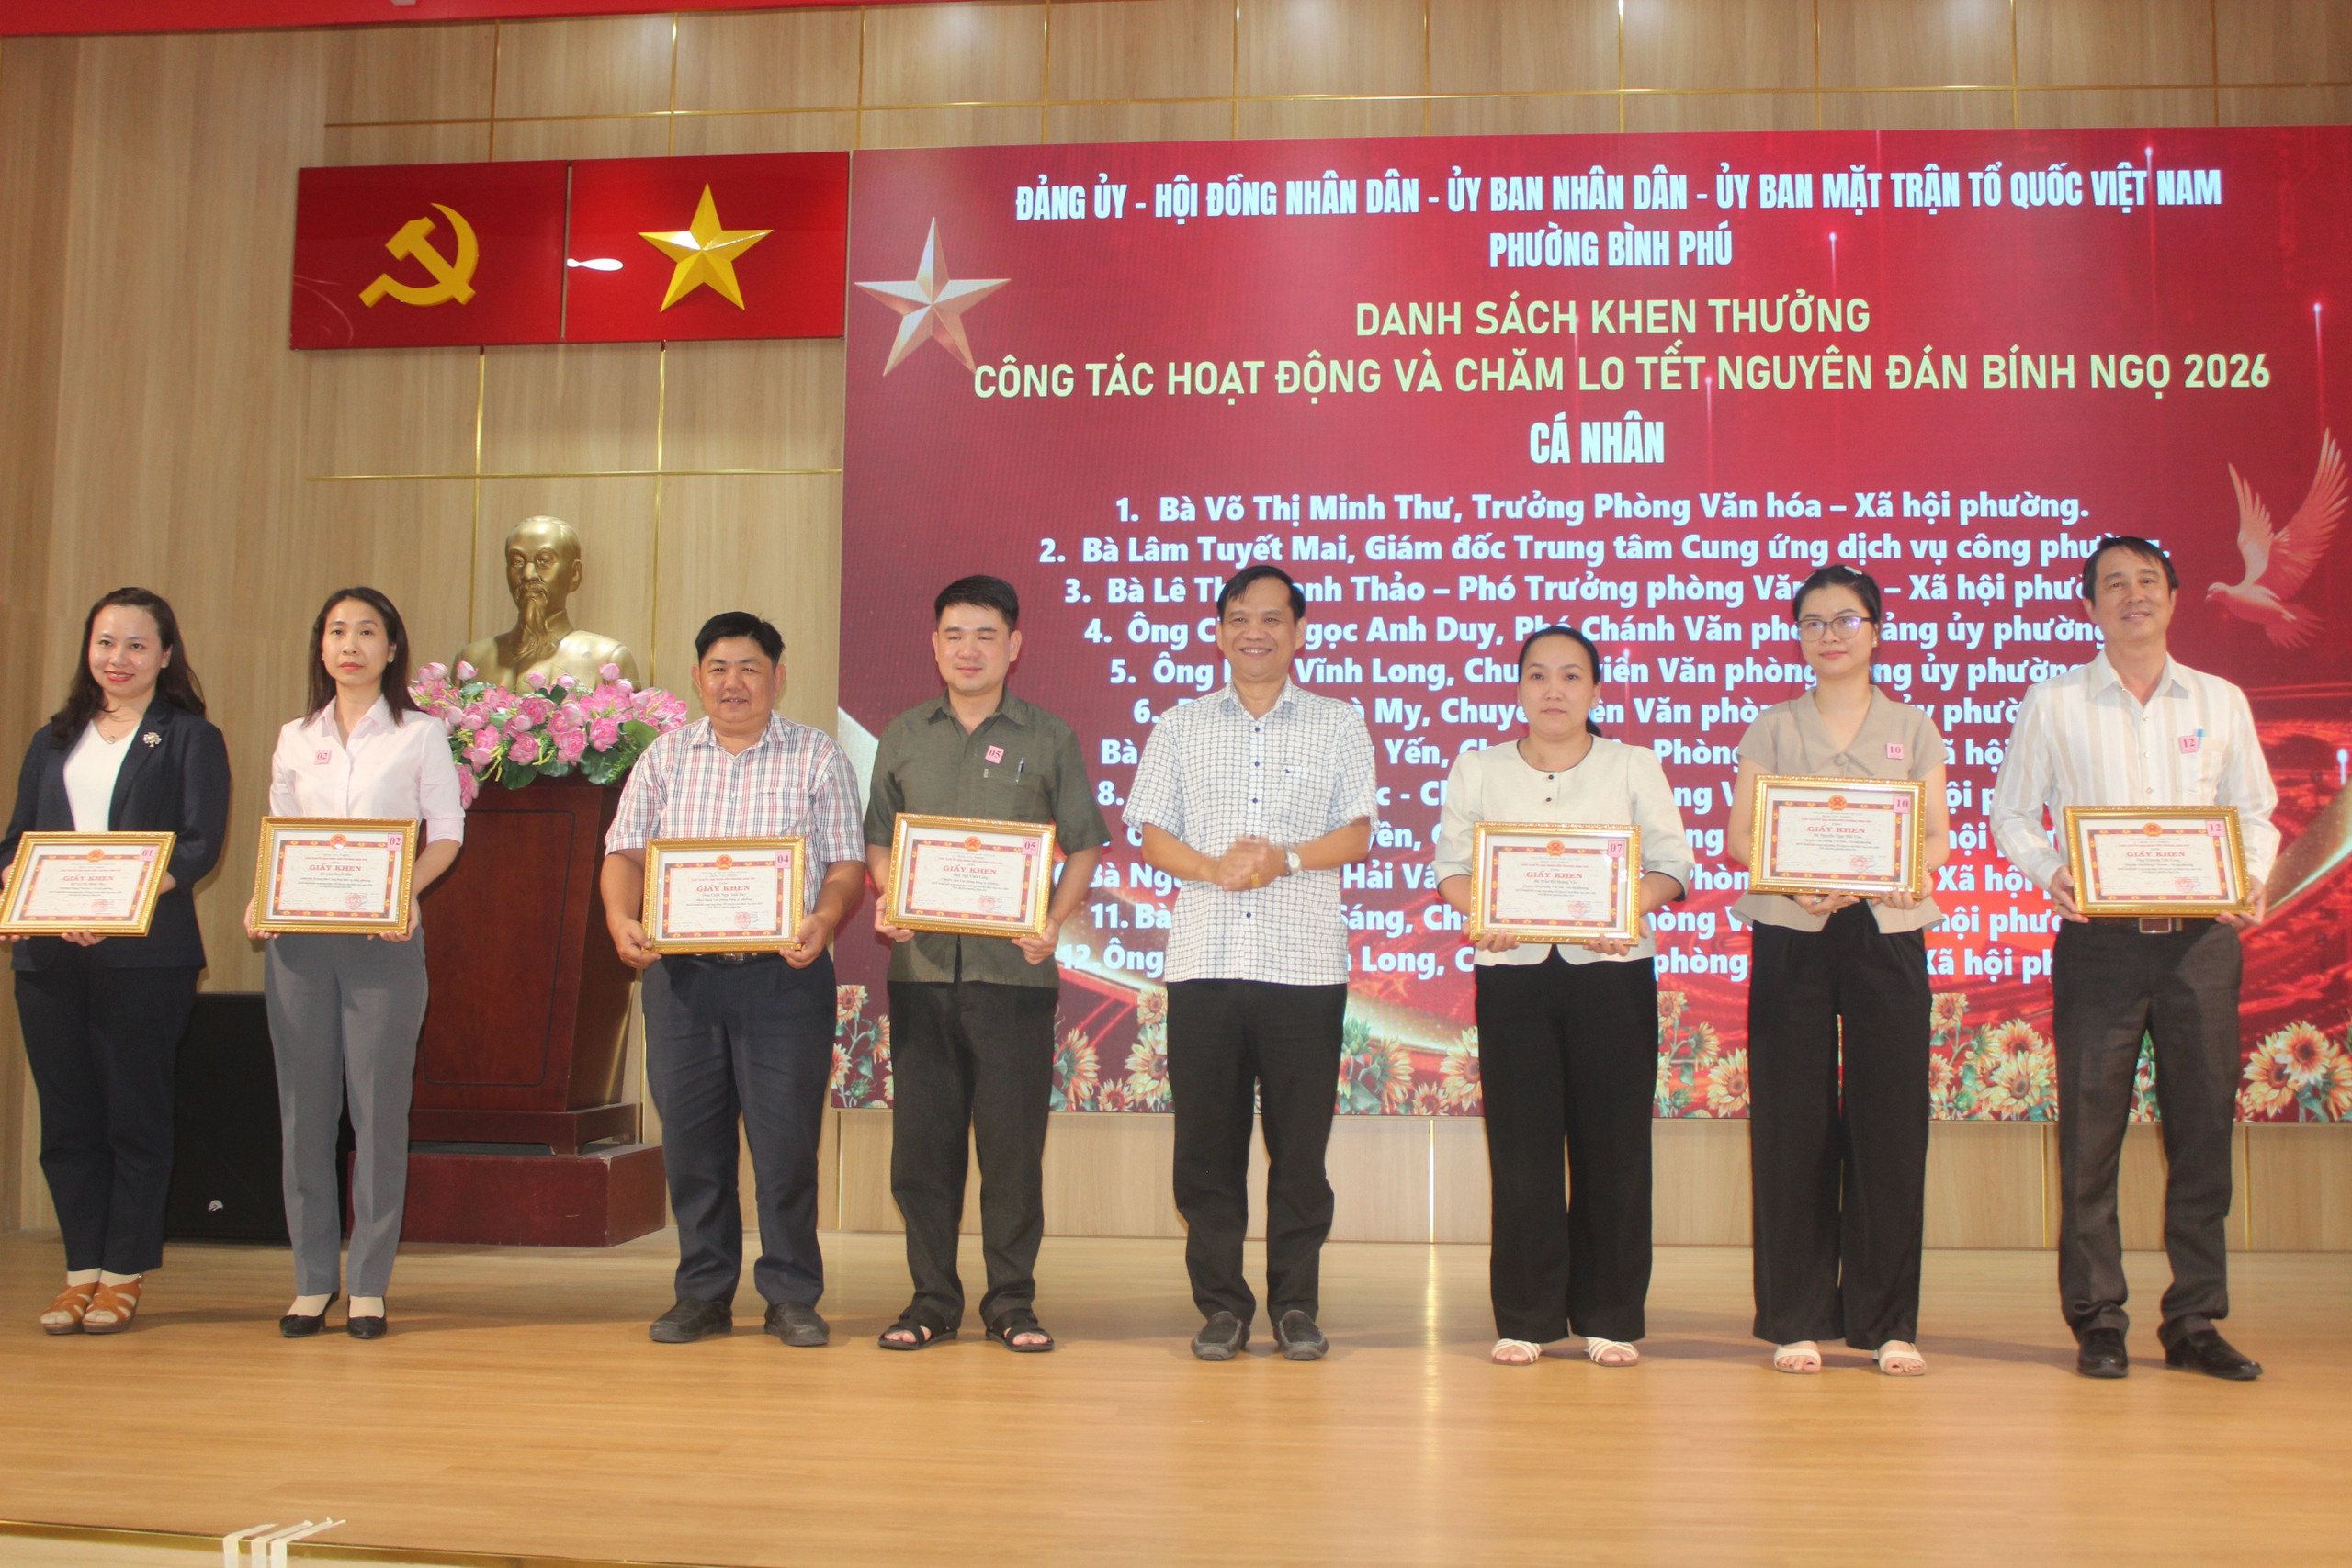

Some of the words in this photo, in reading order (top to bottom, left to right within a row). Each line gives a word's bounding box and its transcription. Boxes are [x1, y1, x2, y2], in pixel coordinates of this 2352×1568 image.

[1015, 174, 1086, 220] ĐẢNG
[1093, 173, 1127, 219] ỦY
[1155, 175, 1198, 225] HỘI
[1205, 174, 1277, 217] ĐỒNG
[1286, 170, 1357, 216] NHÂN
[1366, 168, 1419, 214] DÂN
[1448, 165, 1482, 212] ỦY
[1490, 176, 1544, 212] BAN
[1553, 166, 1624, 211] NHÂN
[1634, 164, 1688, 210] DÂN
[1716, 162, 1750, 209] ỦY
[1759, 173, 1813, 209] BAN
[1822, 164, 1882, 216] MẶT
[1891, 164, 1961, 215] TRẬN
[1968, 161, 2003, 207] TỔ
[2010, 163, 2083, 209] QUỐC
[2091, 162, 2148, 214] VIỆT
[2156, 169, 2222, 206] NAM
[1489, 221, 1600, 268] PHƯỜNG
[1608, 221, 1670, 266] BÌNH
[1679, 220, 1733, 265] PHÚ
[1356, 302, 1461, 336] DANH
[1475, 291, 1577, 335] SÁCH
[1591, 299, 1696, 333] KHEN
[1708, 289, 1871, 333] THƯỞNG
[974, 355, 1075, 399] CÔNG
[1085, 353, 1155, 397] TÁC
[1168, 361, 1265, 405] HOẠT
[1275, 349, 1381, 404] ĐỘNG
[1394, 348, 1443, 392] VÀ
[1454, 348, 1564, 392] CHĂM
[1578, 357, 1625, 390] LO
[1635, 339, 1707, 390] TẾT
[1718, 345, 1872, 389] NGUYÊN
[1885, 344, 1968, 389] ĐÁN
[1983, 344, 2075, 389] BÍNH
[2090, 354, 2171, 400] NGỌ
[2184, 354, 2270, 388] 2026
[1529, 412, 1571, 464] CÁ
[1579, 410, 1665, 463] NHÂN
[1116, 497, 1139, 522] 1.
[1159, 495, 1195, 522] Bà
[1204, 495, 1245, 521] Võ
[1252, 493, 1300, 527] Thị
[1309, 493, 1385, 520] Minh
[1393, 493, 1464, 523] Thư,
[1472, 490, 1585, 526] Trưởng
[1594, 492, 1690, 526] Phòng
[1700, 492, 1758, 518] Văn
[1766, 491, 1822, 518] hóa
[1854, 491, 1894, 518] Xã
[1902, 491, 1951, 525] hội
[1959, 491, 2089, 526] phường.
[1039, 538, 1066, 563] 2.
[1082, 536, 1119, 562] Bà
[1128, 536, 1189, 562] Lâm
[1197, 534, 1283, 569] Tuyết
[1291, 534, 1356, 565] Mai,
[1364, 533, 1442, 560] Giám
[1451, 532, 1506, 560] đốc
[1513, 534, 1605, 567] Trung
[1613, 534, 1672, 559] tâm
[1681, 534, 1759, 567] Cung
[1768, 533, 1829, 567] ứng
[1838, 532, 1902, 566] dịch
[1909, 539, 1949, 566] vụ
[1956, 533, 2030, 567] công
[1064, 578, 1091, 604] 3.
[1107, 576, 1145, 604] Bà
[1154, 576, 1187, 603] Lê
[1194, 576, 1227, 603] Th
[1350, 570, 1426, 602] Thảo
[1458, 574, 1517, 601] Phó
[1523, 570, 1638, 609] Trưởng
[1646, 574, 1744, 609] phòng
[1908, 573, 1950, 600] Xã
[1957, 572, 2005, 607] hội
[1083, 618, 1113, 644] 4.
[1127, 611, 1189, 650] Ông
[1305, 623, 1358, 650] gọc
[1365, 615, 1427, 642] Anh
[1436, 616, 1504, 650] Duy,
[1580, 615, 1675, 642] Chánh
[1683, 615, 1742, 641] Văn
[1881, 611, 1939, 649] ảng
[1947, 611, 1985, 649] ủy
[1110, 658, 1136, 684] 5.
[1152, 651, 1215, 691] Ông
[1294, 657, 1363, 683] Vĩnh
[1372, 657, 1455, 691] Long,
[1600, 655, 1649, 682] iên
[1657, 656, 1716, 682] Văn
[1724, 656, 1818, 691] phòng
[1920, 653, 1960, 691] ủy
[1967, 656, 2086, 692] phườn
[1133, 698, 1160, 724] 6.
[1374, 697, 1430, 731] My,
[1440, 697, 1530, 731] Chuy
[1633, 696, 1692, 724] Văn
[1101, 739, 1138, 765] Bà
[1384, 736, 1450, 769] Yến,
[1890, 746, 1901, 754] 10
[2183, 738, 2196, 748] 12
[1097, 780, 1125, 807] 8.
[1896, 799, 1909, 808] 10
[1945, 779, 1973, 815] ội
[389, 837, 401, 846] 02
[1836, 826, 1866, 834] KHEN
[2209, 823, 2222, 832] 12
[141, 849, 153, 857] 01
[777, 854, 789, 863] 04
[1024, 840, 1037, 851] 05
[1610, 843, 1623, 852] 07
[334, 864, 362, 873] KHEN
[969, 866, 998, 875] KHEN
[1342, 858, 1394, 889] Hải
[1689, 863, 1750, 891] hòn
[1935, 864, 1975, 892] Xã
[1091, 903, 1129, 929] 11.
[1135, 902, 1172, 929] Bà
[1648, 905, 1716, 940] òng
[1103, 937, 1164, 978] Ông
[1362, 945, 1445, 980] Long,
[1653, 946, 1748, 982] phòng
[1963, 947, 2013, 983] hội
